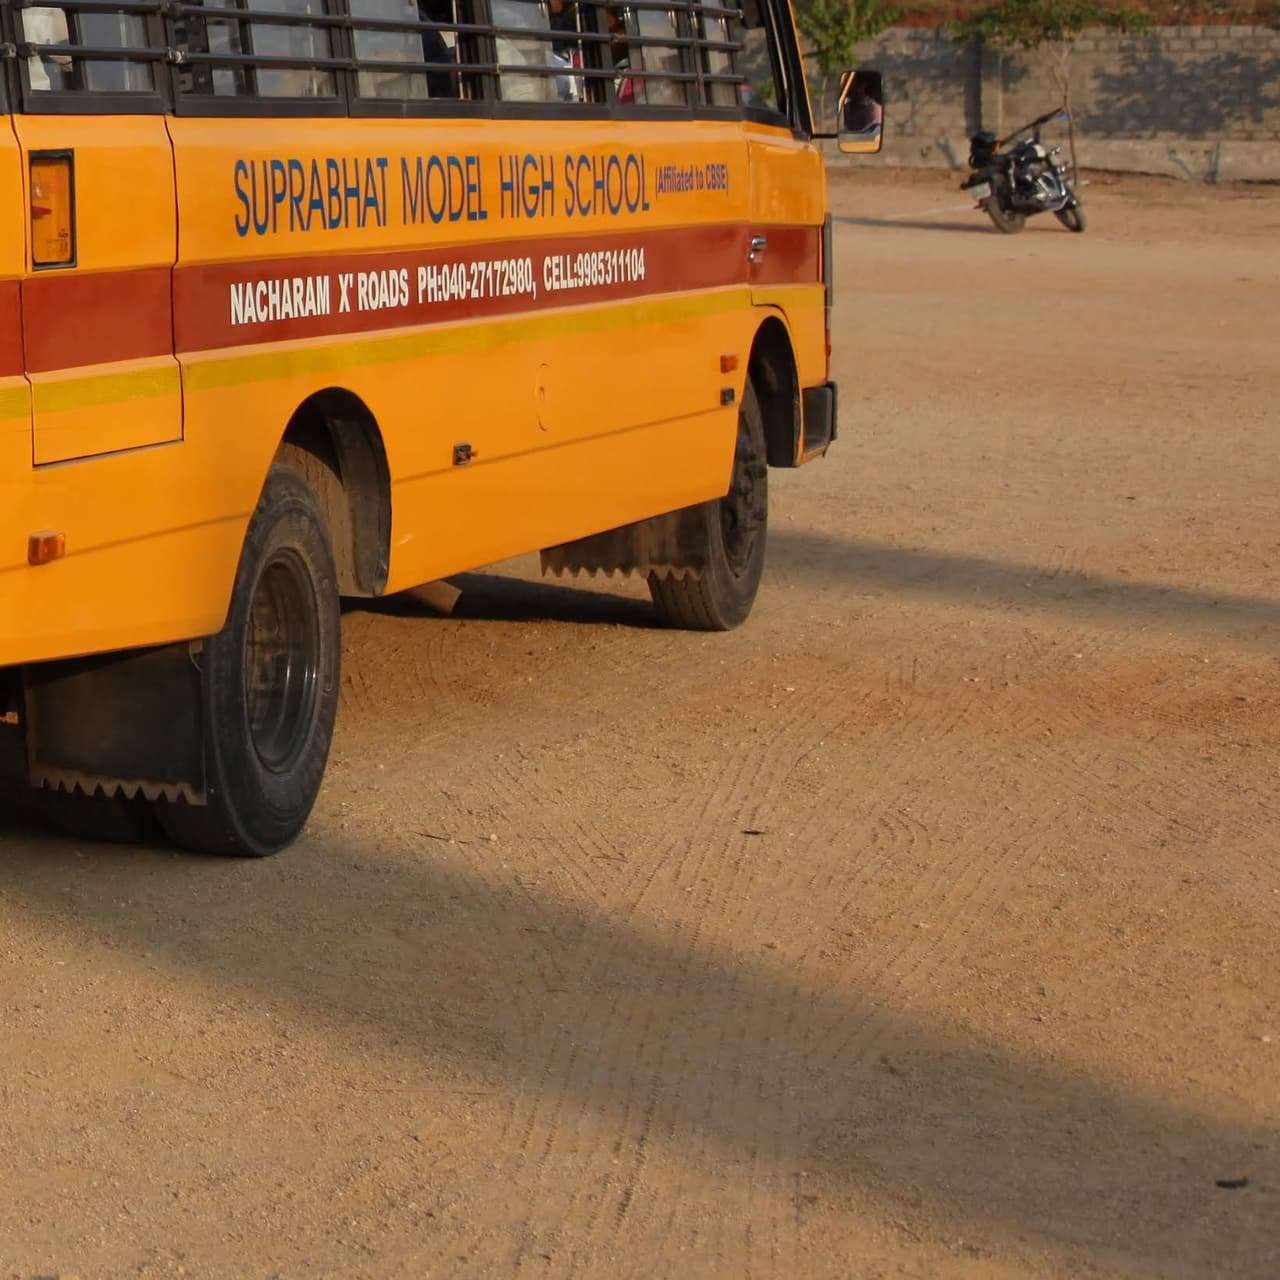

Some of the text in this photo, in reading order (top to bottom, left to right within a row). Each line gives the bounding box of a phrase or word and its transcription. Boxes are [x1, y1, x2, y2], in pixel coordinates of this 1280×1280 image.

[234, 153, 650, 237] SUPRABHAT MODEL HIGH SCHOOL
[695, 165, 704, 190] to
[229, 273, 331, 325] NACHARAM
[357, 268, 409, 310] ROADS
[543, 248, 646, 291] CELL:9985311104
